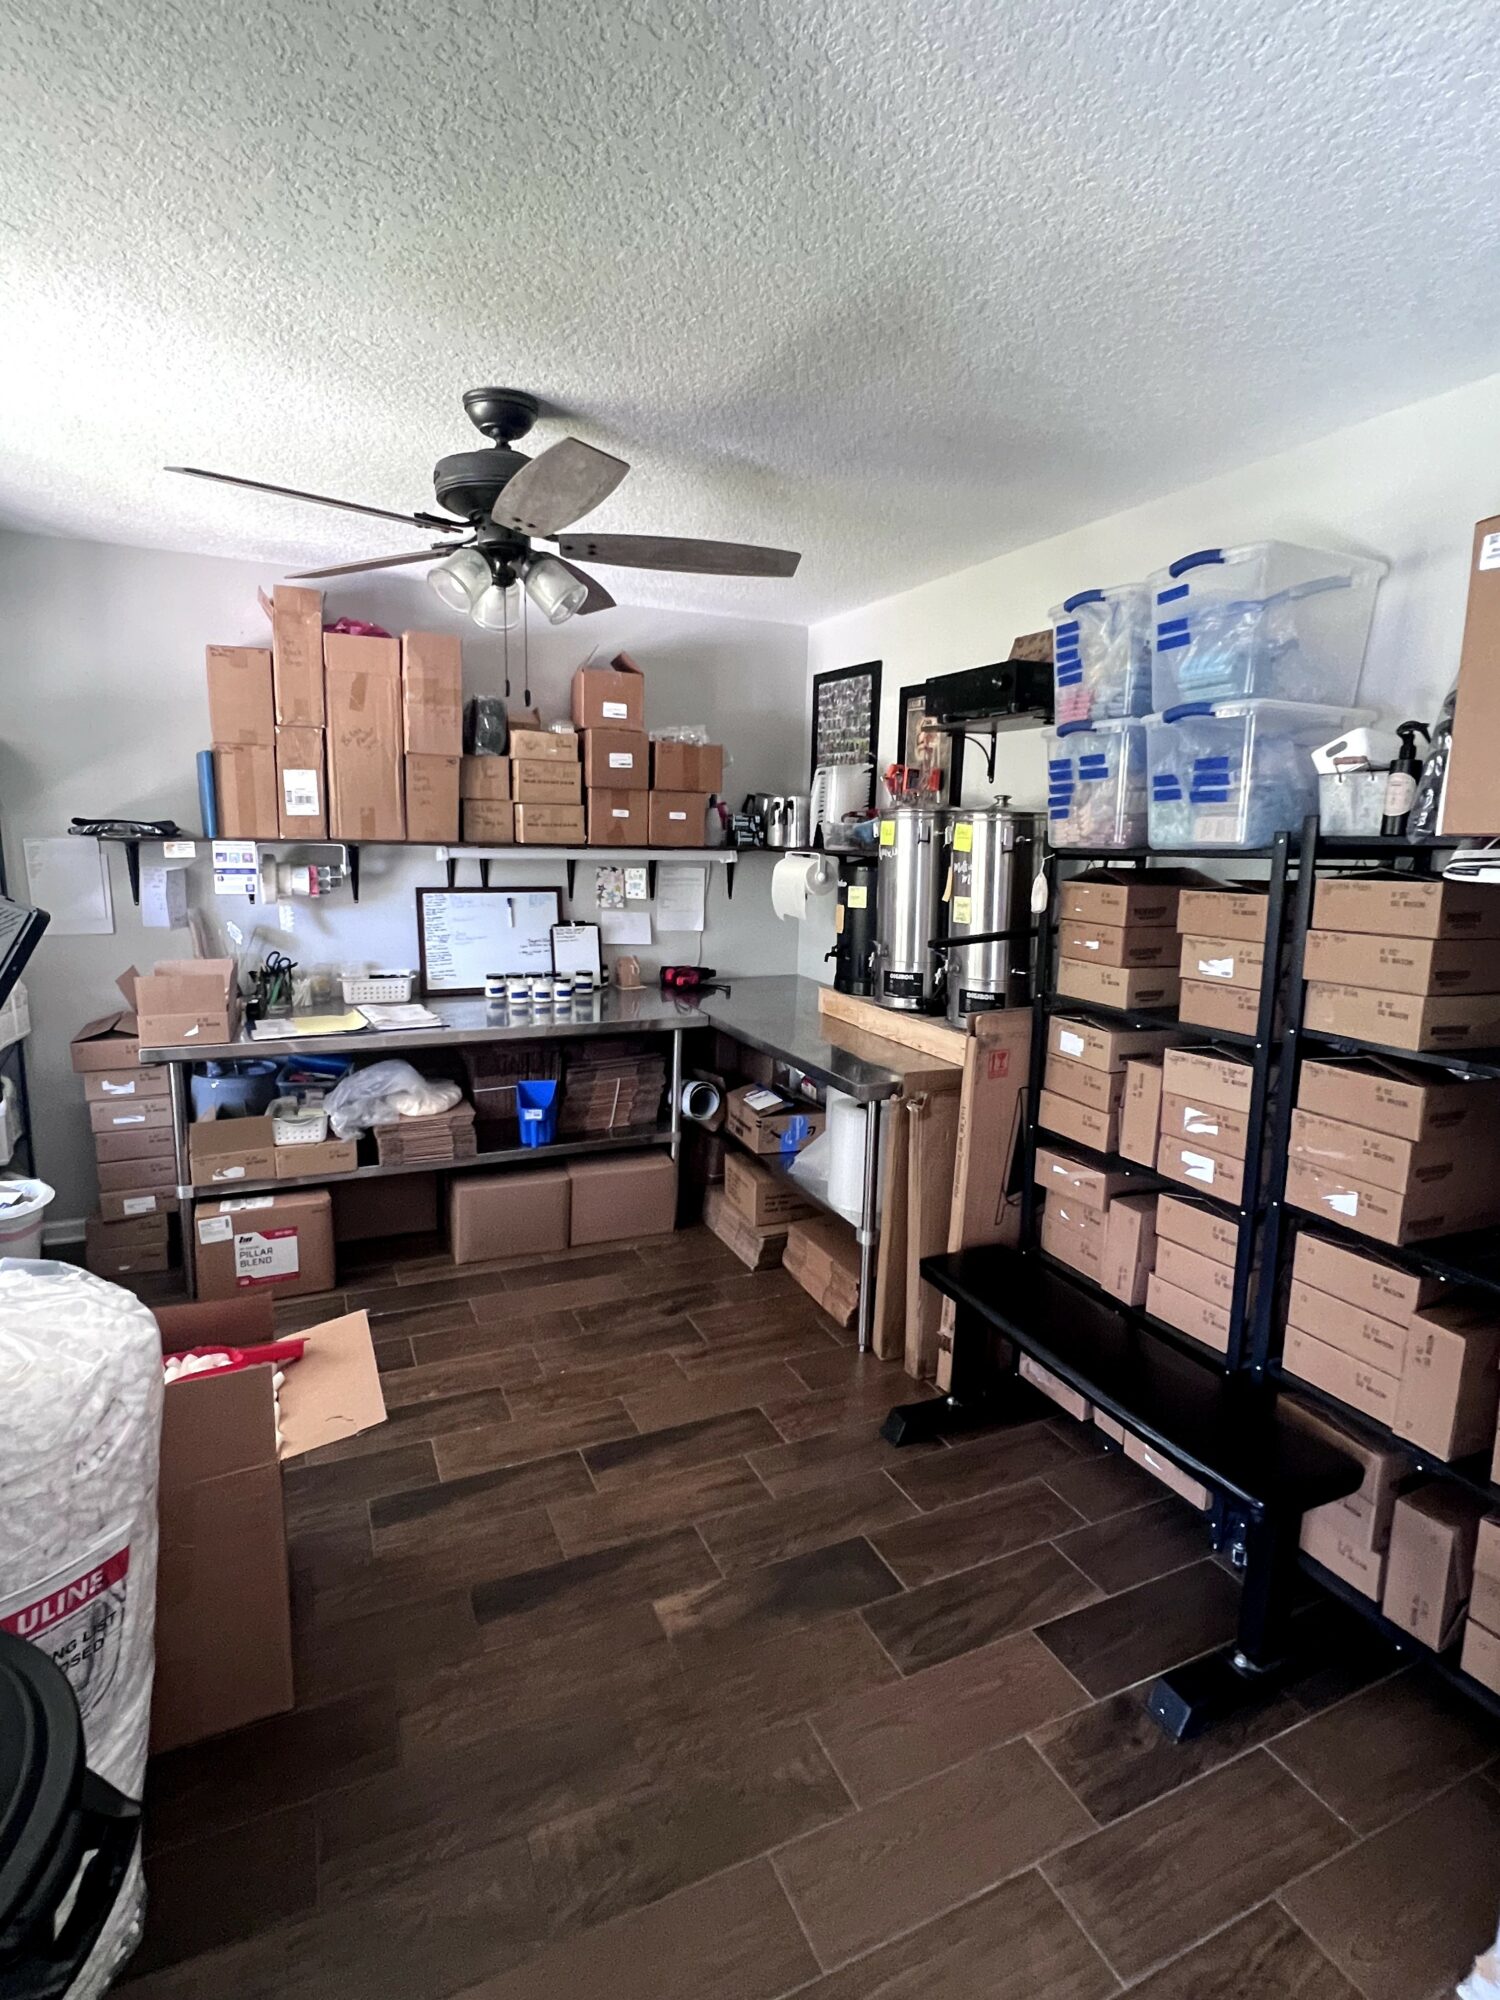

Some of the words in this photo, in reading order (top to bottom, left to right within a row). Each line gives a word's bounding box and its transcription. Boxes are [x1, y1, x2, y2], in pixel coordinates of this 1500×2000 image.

[240, 1247, 273, 1259] PILLAR
[240, 1256, 272, 1268] BLEND
[18, 1570, 103, 1634] ULINE
[83, 1611, 116, 1642] LIST
